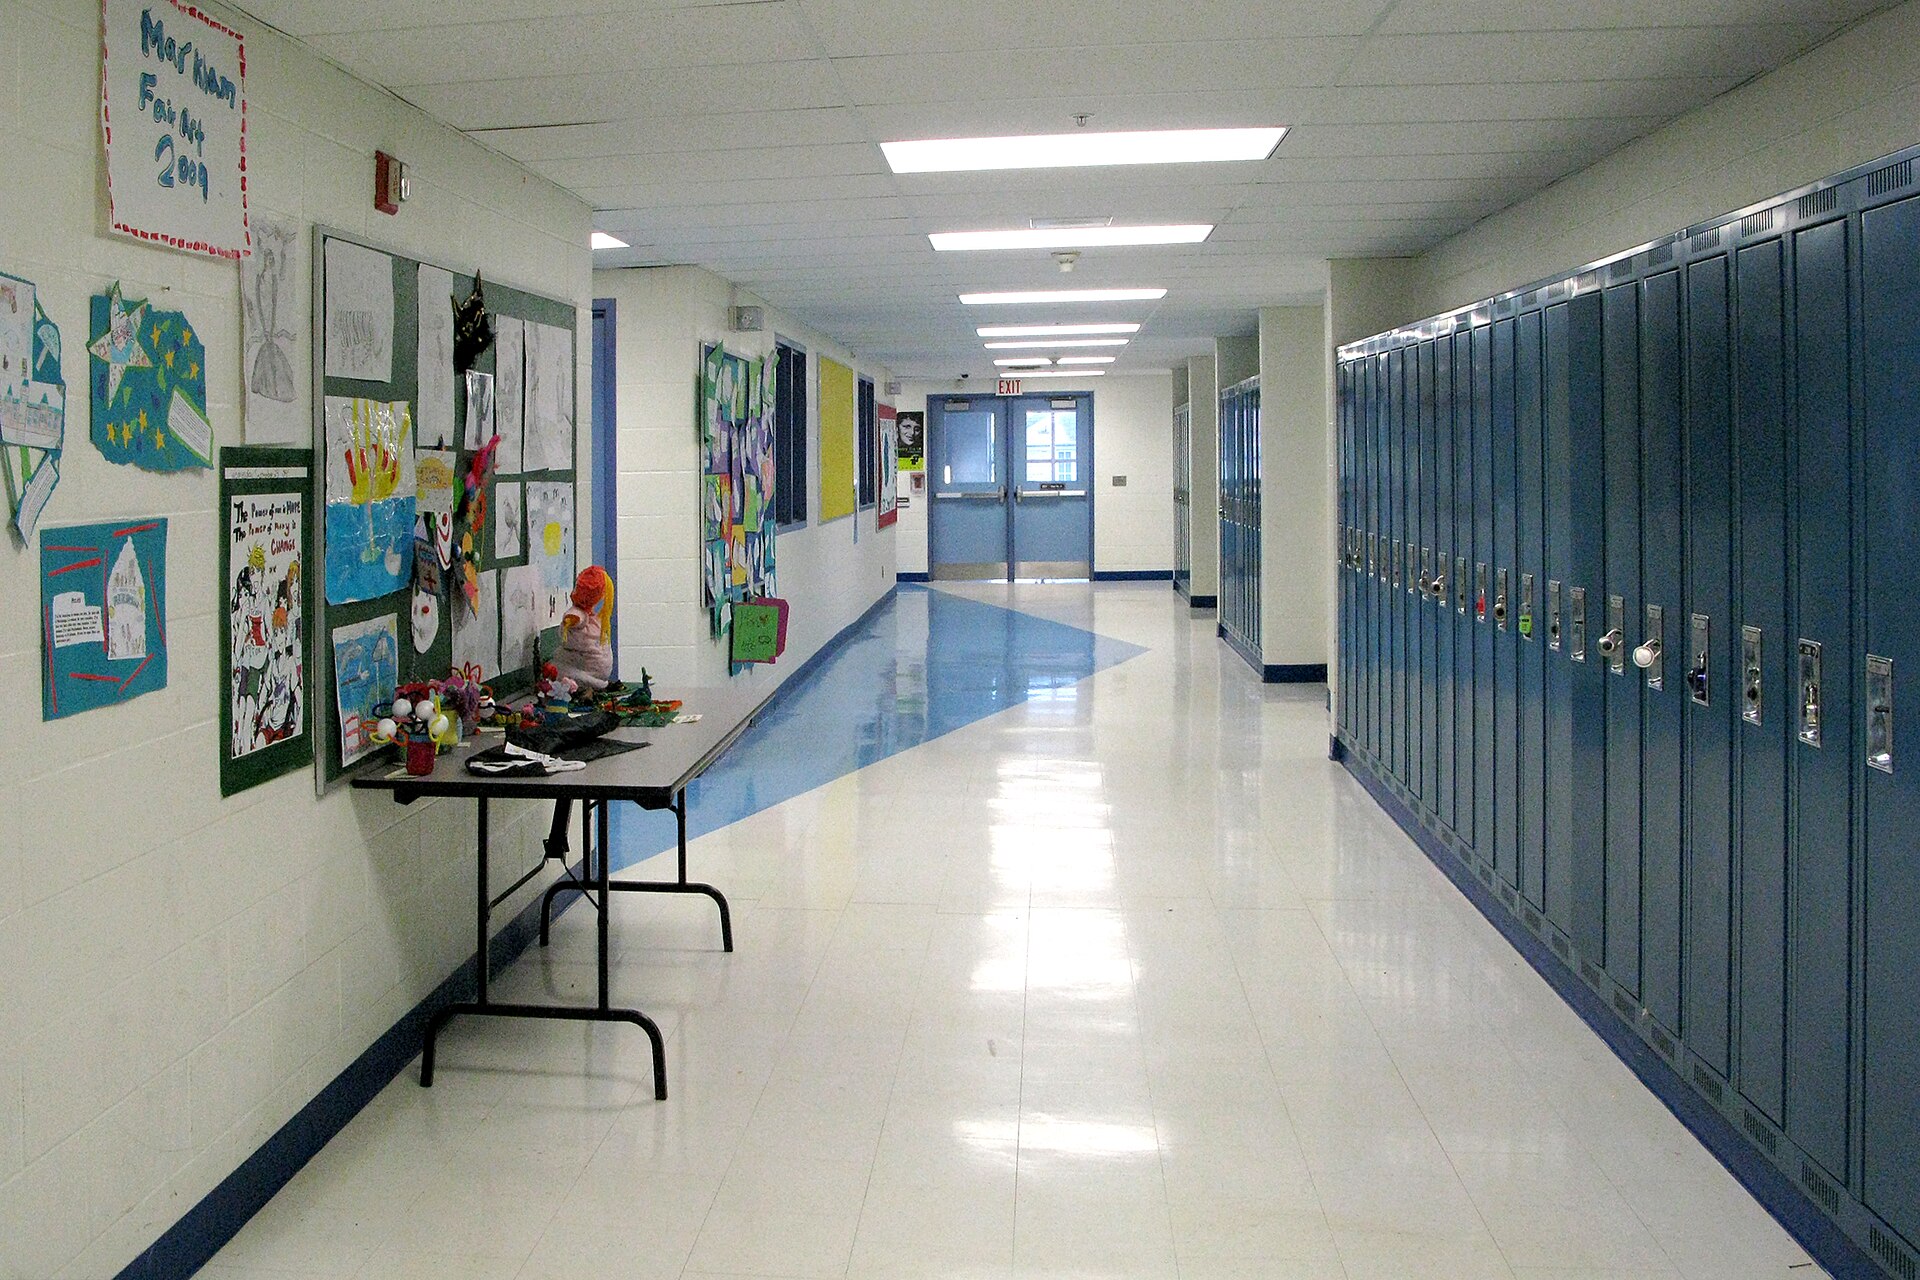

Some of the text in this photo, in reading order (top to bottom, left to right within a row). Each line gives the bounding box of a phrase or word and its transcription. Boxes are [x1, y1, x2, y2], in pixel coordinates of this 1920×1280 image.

[139, 72, 205, 157] Fair Art
[155, 134, 208, 204] 2009
[998, 379, 1021, 394] EXIT
[233, 501, 248, 523] The
[233, 527, 246, 543] The
